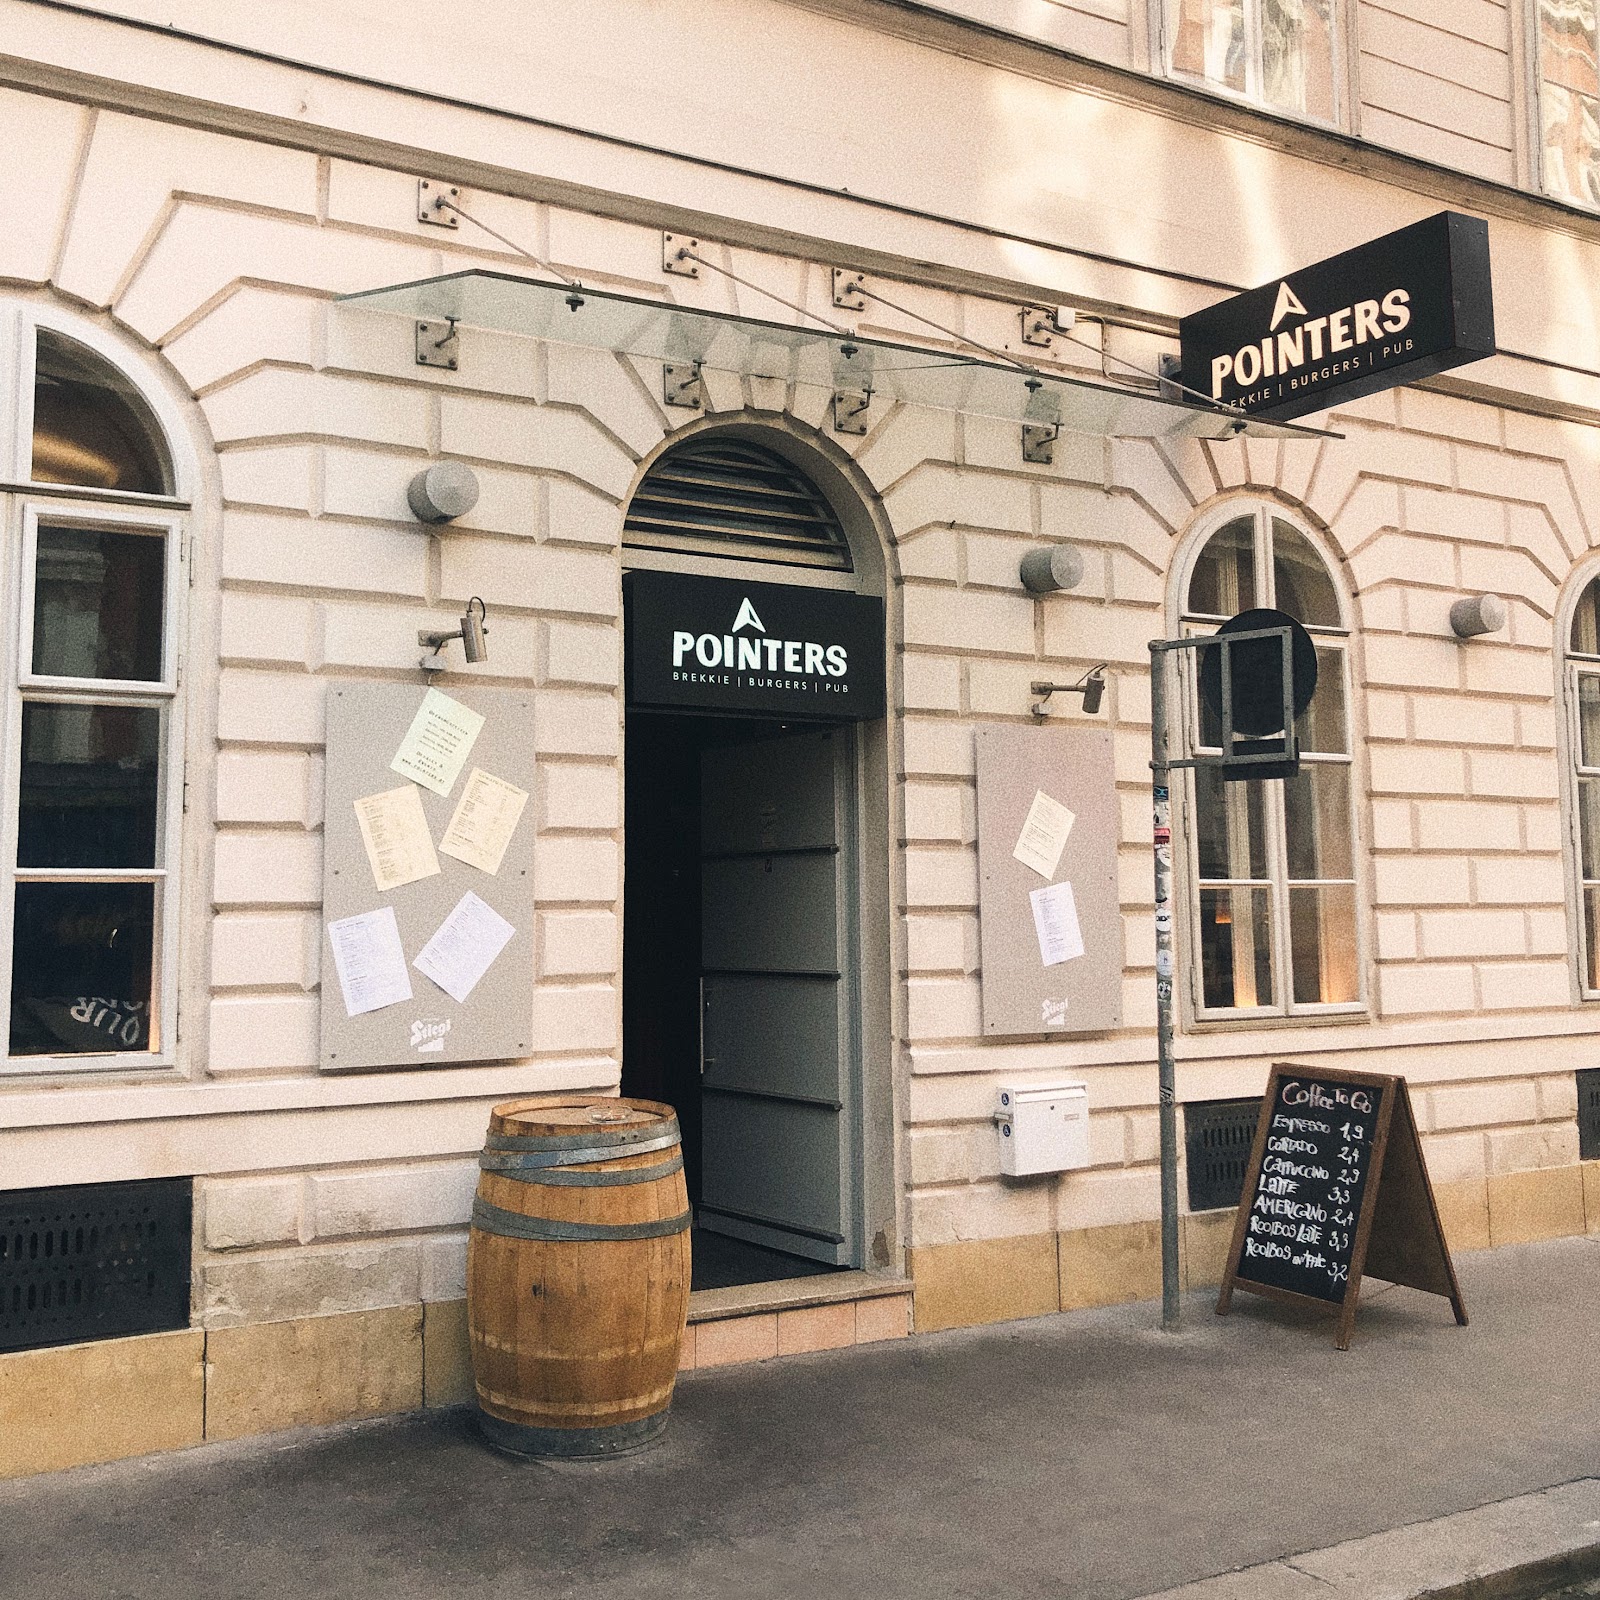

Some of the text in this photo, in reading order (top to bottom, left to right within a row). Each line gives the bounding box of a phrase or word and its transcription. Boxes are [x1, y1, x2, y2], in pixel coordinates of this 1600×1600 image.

[1211, 288, 1411, 400] POINTERS
[1290, 357, 1361, 390] BURGERS
[1383, 339, 1415, 358] PUB
[672, 631, 849, 677] POINTERS
[673, 672, 849, 693] BREKKIE BURGERS PUB
[1282, 1082, 1335, 1110] Coffee
[1331, 1088, 1348, 1104] To
[1340, 1122, 1364, 1141] 1,9
[1337, 1146, 1360, 1165] 2,4
[1337, 1168, 1360, 1185] 2,9
[1327, 1186, 1350, 1204] 3,3
[1331, 1208, 1354, 1226] 2,4
[1328, 1231, 1349, 1251] 3,3
[1327, 1262, 1348, 1282] 3,2
